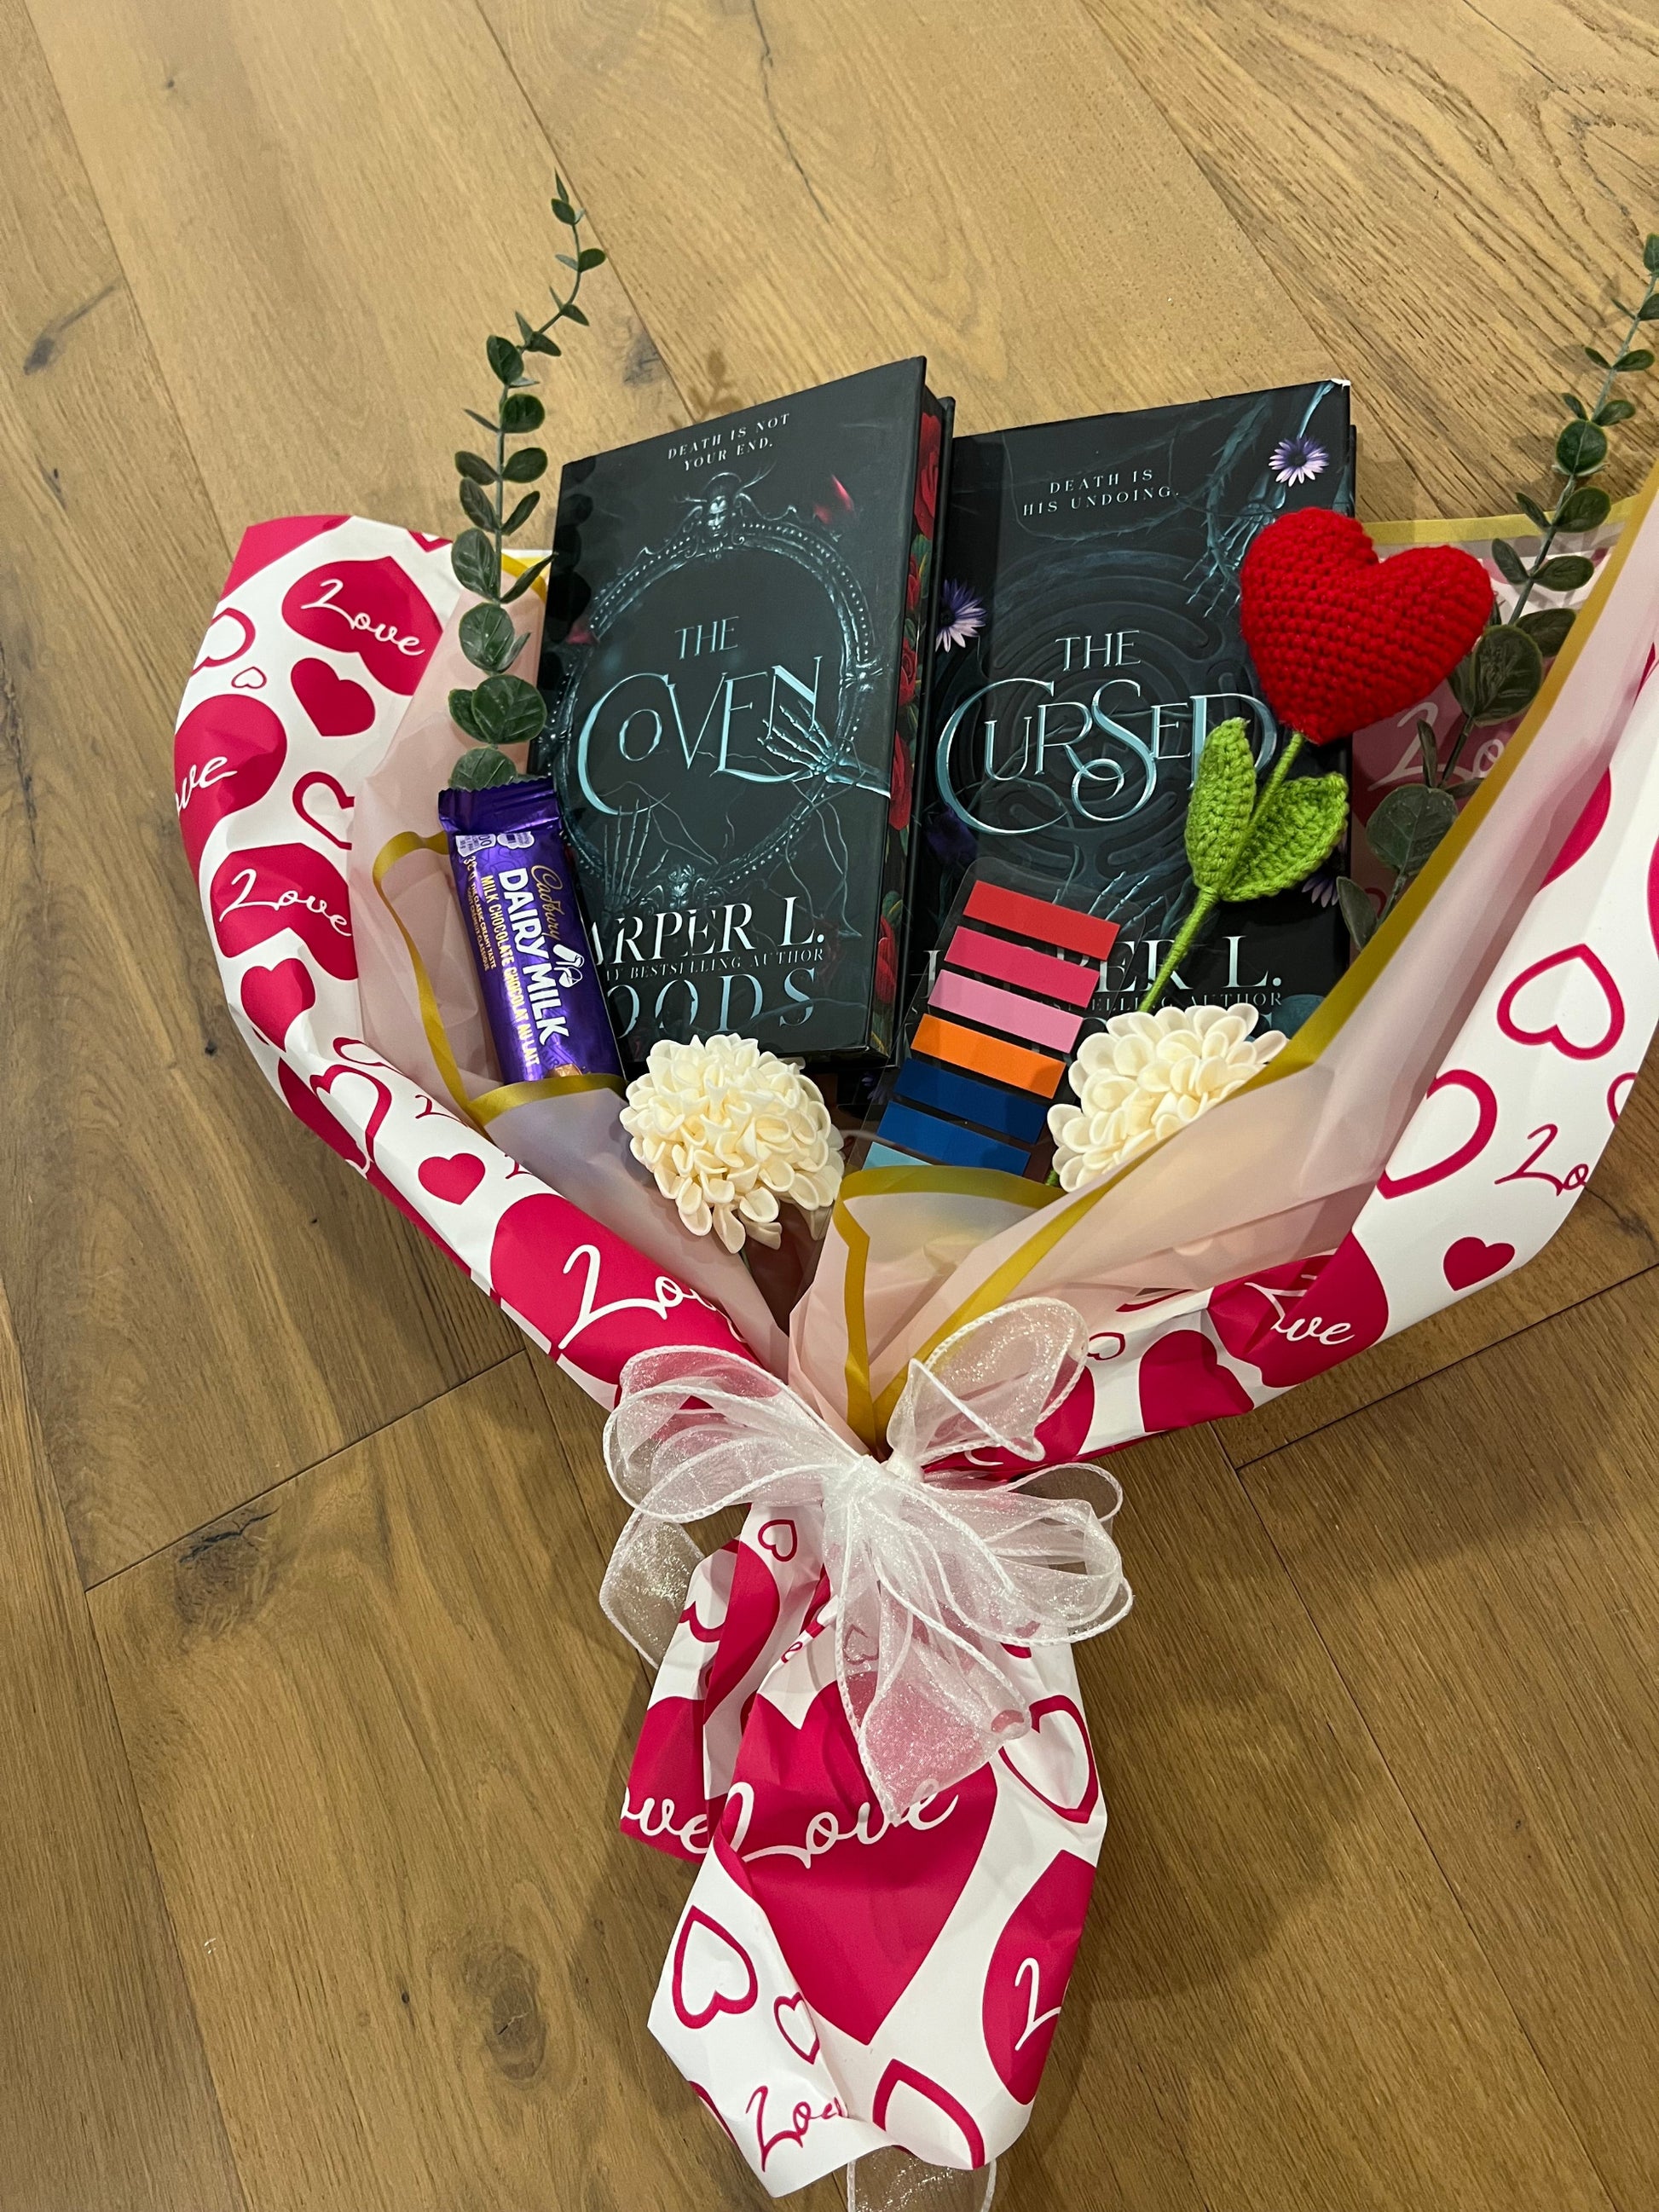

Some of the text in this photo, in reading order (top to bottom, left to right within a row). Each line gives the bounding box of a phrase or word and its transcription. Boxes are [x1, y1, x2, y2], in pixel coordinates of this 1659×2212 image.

[668, 413, 790, 459] DEATH IS NOT
[684, 436, 773, 471] YOUR END.
[1023, 485, 1179, 517] HIS UNDOING.
[1049, 469, 1153, 494] DEATH IS
[300, 578, 425, 656] Love
[674, 615, 740, 661] THE
[1055, 629, 1142, 672] THE
[577, 656, 824, 816] COVEN
[936, 678, 1277, 836] CURSED
[219, 868, 352, 937] Love
[481, 875, 500, 904] MILK
[498, 867, 550, 960] DAIRY
[530, 864, 565, 941] Cadbury
[474, 894, 484, 923] CLASSIC
[480, 921, 491, 950] CREAMY
[486, 948, 496, 970] TASTE
[488, 904, 515, 967] CHOCOLATE
[777, 896, 825, 947] L.
[1221, 935, 1282, 989] L.
[522, 962, 569, 1046] MILK
